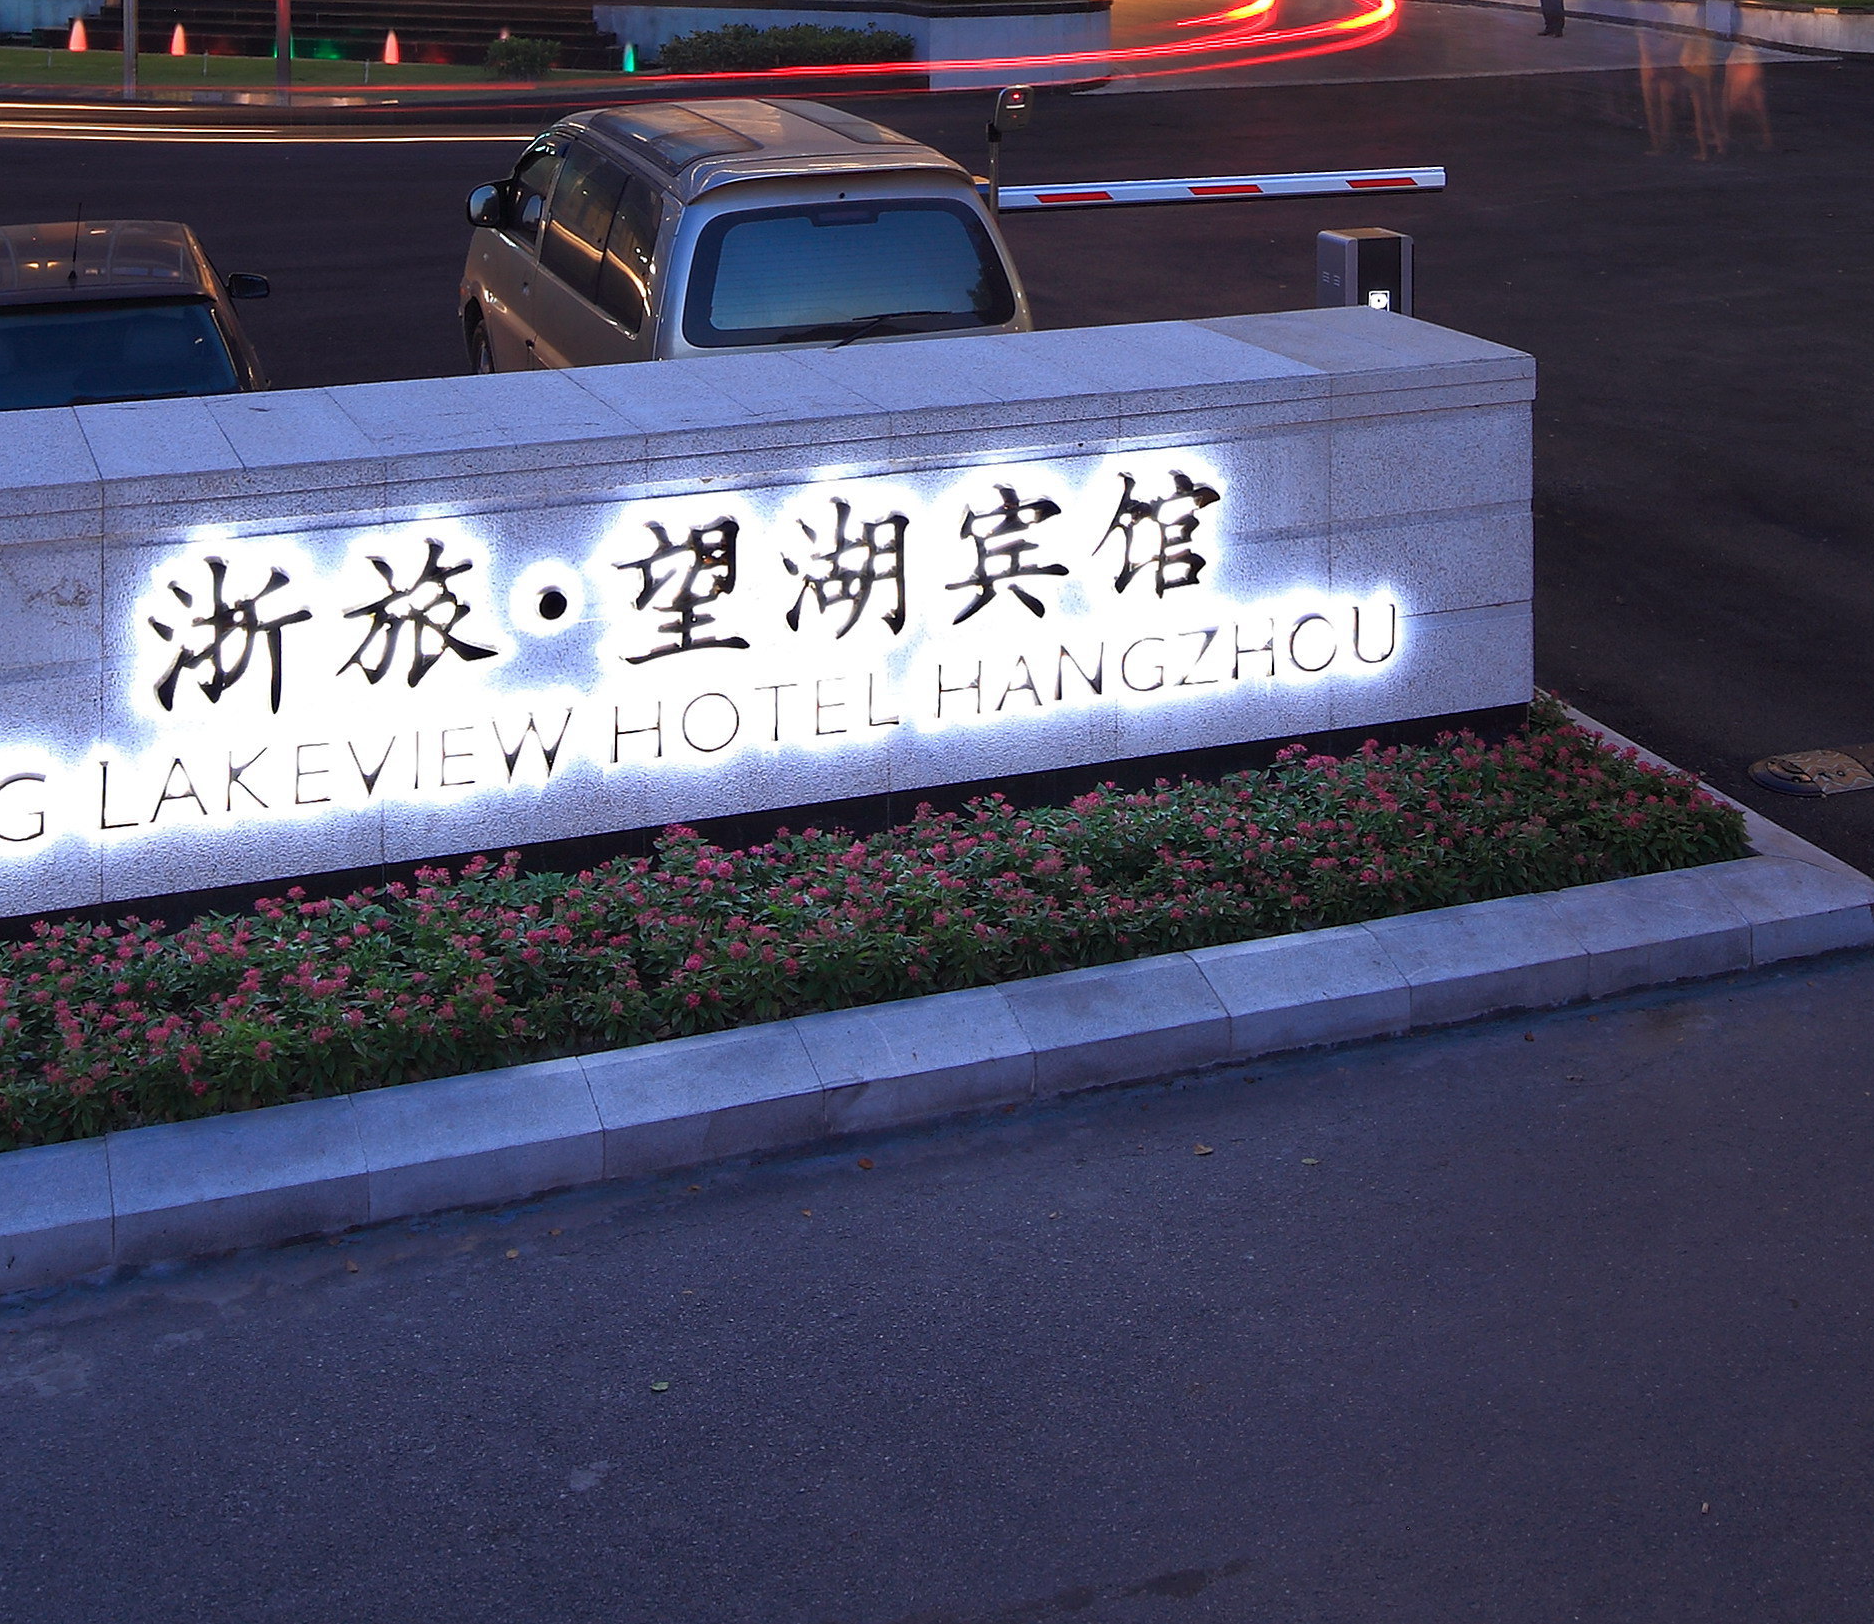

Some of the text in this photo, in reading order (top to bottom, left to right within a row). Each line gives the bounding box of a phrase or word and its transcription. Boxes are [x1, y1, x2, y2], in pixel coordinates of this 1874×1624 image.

[147, 468, 1221, 714] 浙旅·望湖宾馆
[99, 707, 573, 829] LAKEVIEW
[610, 673, 900, 763] HOTEL
[936, 603, 1397, 718] HANGZHOU
